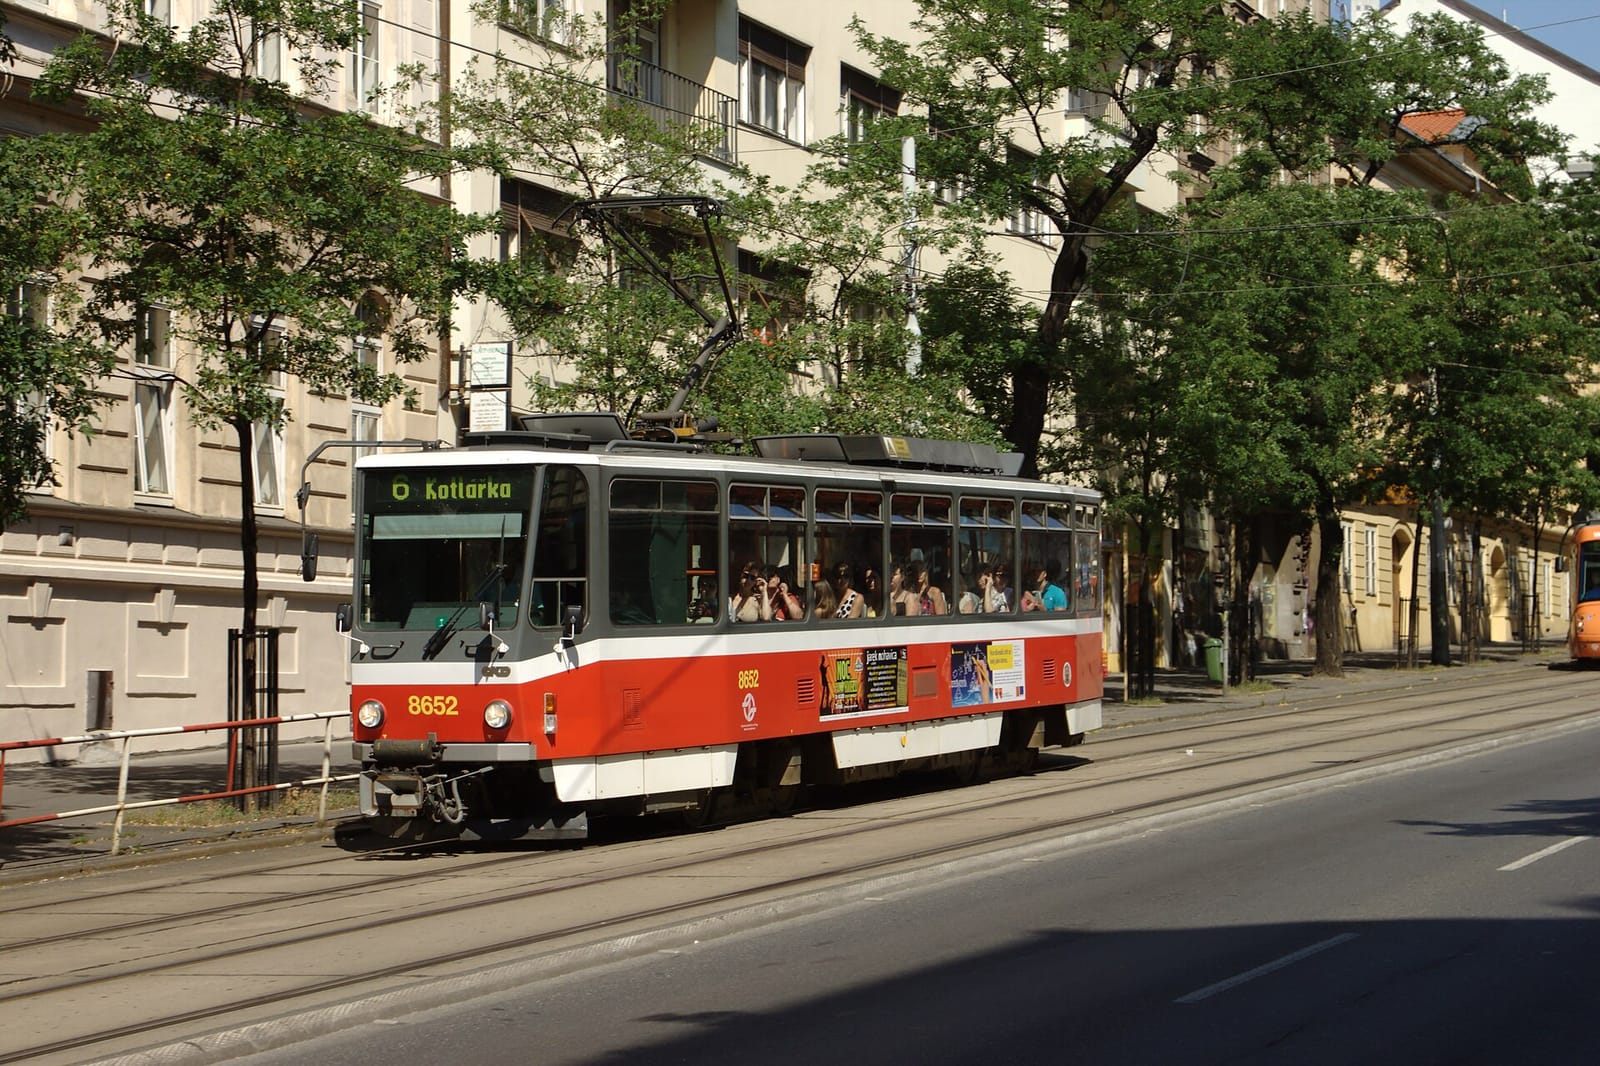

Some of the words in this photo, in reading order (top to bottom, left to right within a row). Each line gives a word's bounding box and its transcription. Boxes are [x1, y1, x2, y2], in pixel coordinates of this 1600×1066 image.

[392, 474, 410, 501] 6
[738, 669, 760, 690] 8652
[408, 694, 459, 716] 8652
